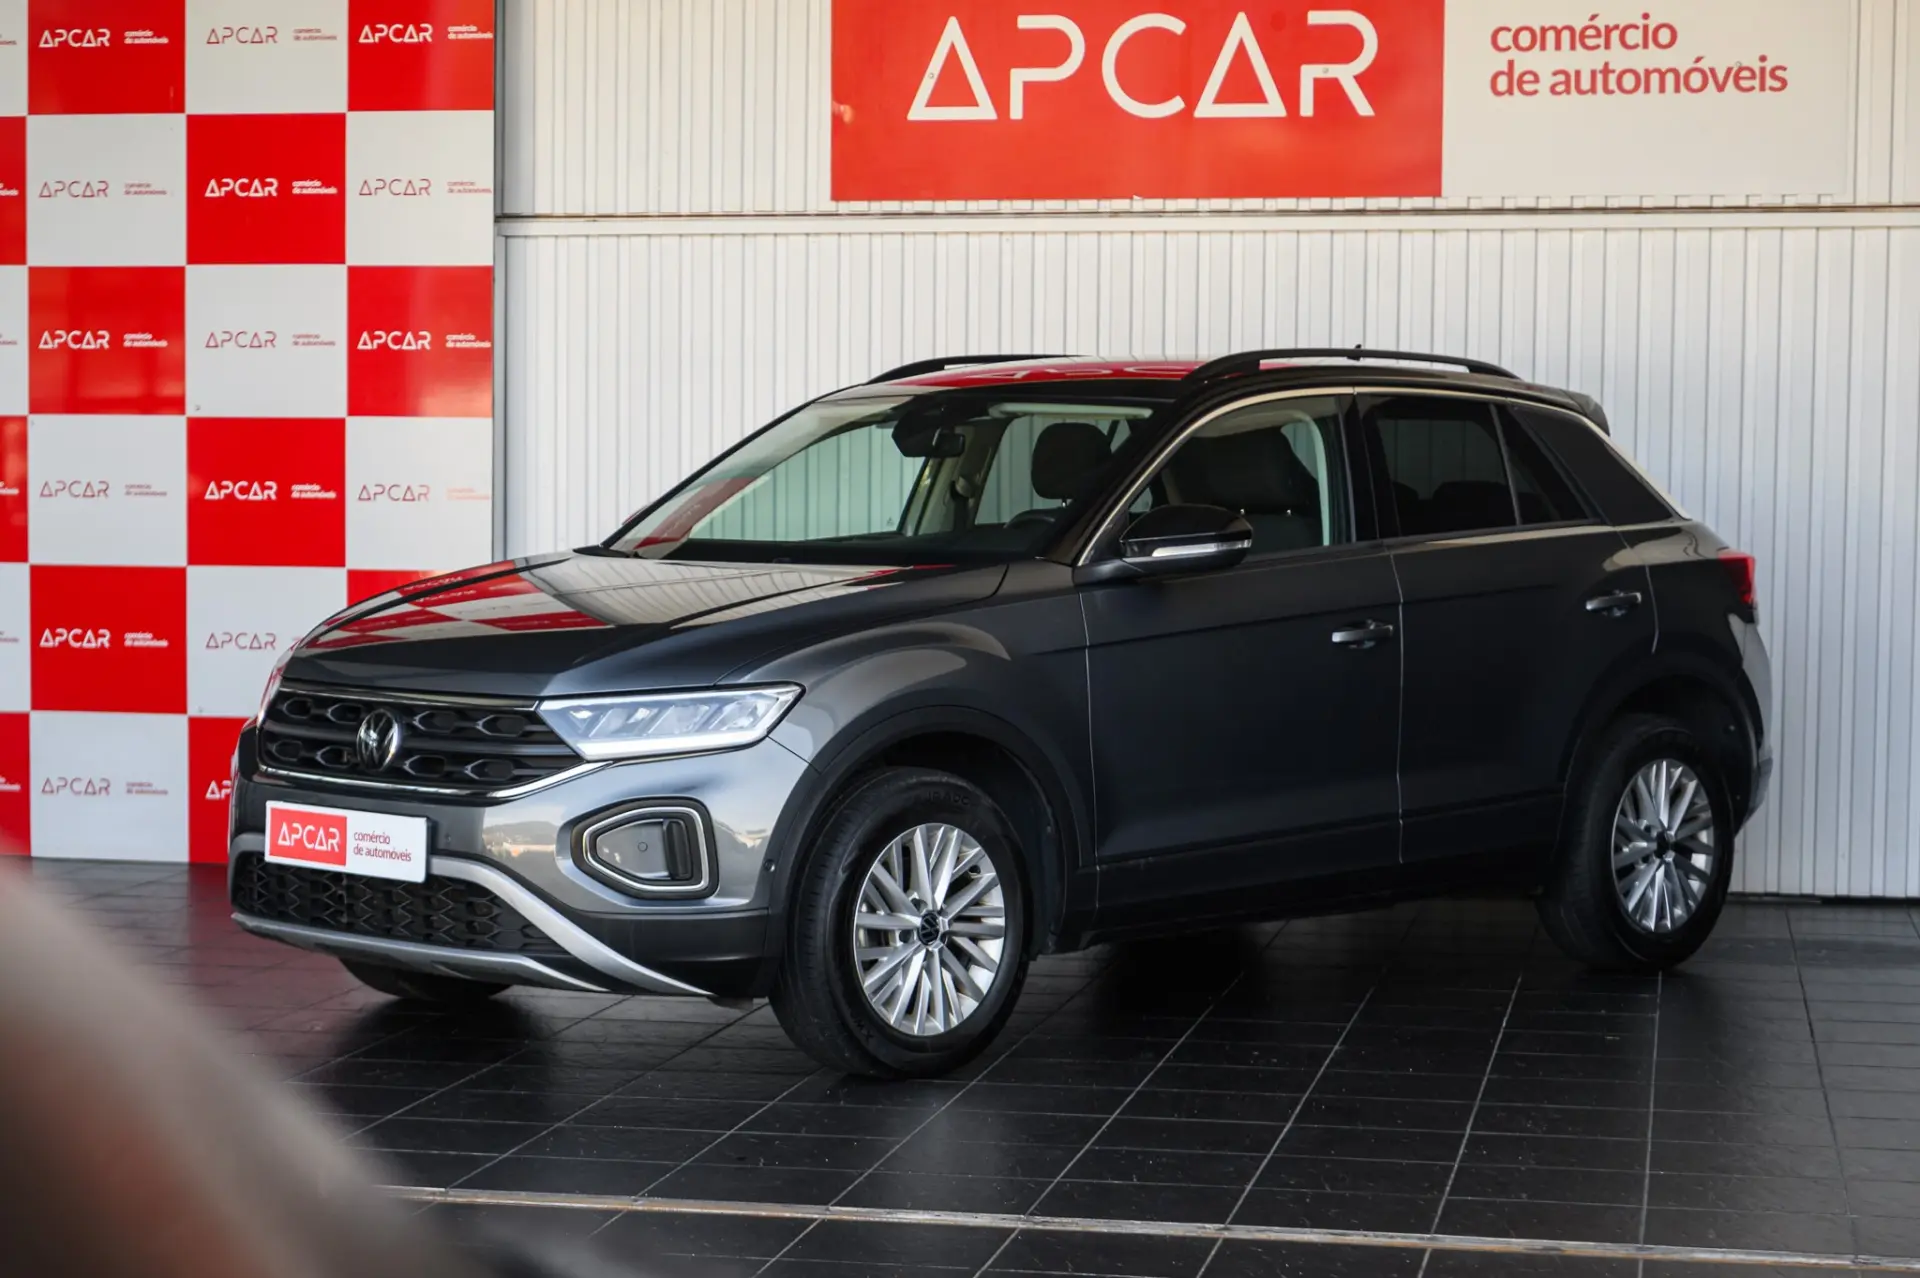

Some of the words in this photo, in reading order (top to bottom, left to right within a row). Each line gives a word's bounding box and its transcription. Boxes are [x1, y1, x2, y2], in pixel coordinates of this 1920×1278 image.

[38, 29, 110, 47] APCAR
[206, 26, 277, 44] APCAR
[358, 24, 432, 43] APCAR
[1490, 12, 1678, 52] comércio
[907, 11, 1379, 121] APCAR
[1490, 60, 1539, 96] de
[1549, 54, 1788, 95] automóveis
[38, 181, 109, 198] APCAR
[205, 178, 278, 197] APCAR
[358, 179, 431, 195] APCAR
[38, 330, 110, 350] APCAR
[205, 331, 276, 348] APCAR
[357, 331, 431, 350] APCAR
[40, 481, 109, 498] APCAR
[204, 481, 278, 501] APCAR
[358, 484, 430, 502] APCAR
[40, 628, 110, 649] APCAR
[206, 632, 276, 650] APCAR
[42, 777, 110, 795] APCAR
[277, 821, 341, 853] APCAR
[353, 830, 391, 846] comércio
[353, 845, 364, 856] de
[365, 847, 413, 862] automóveis
